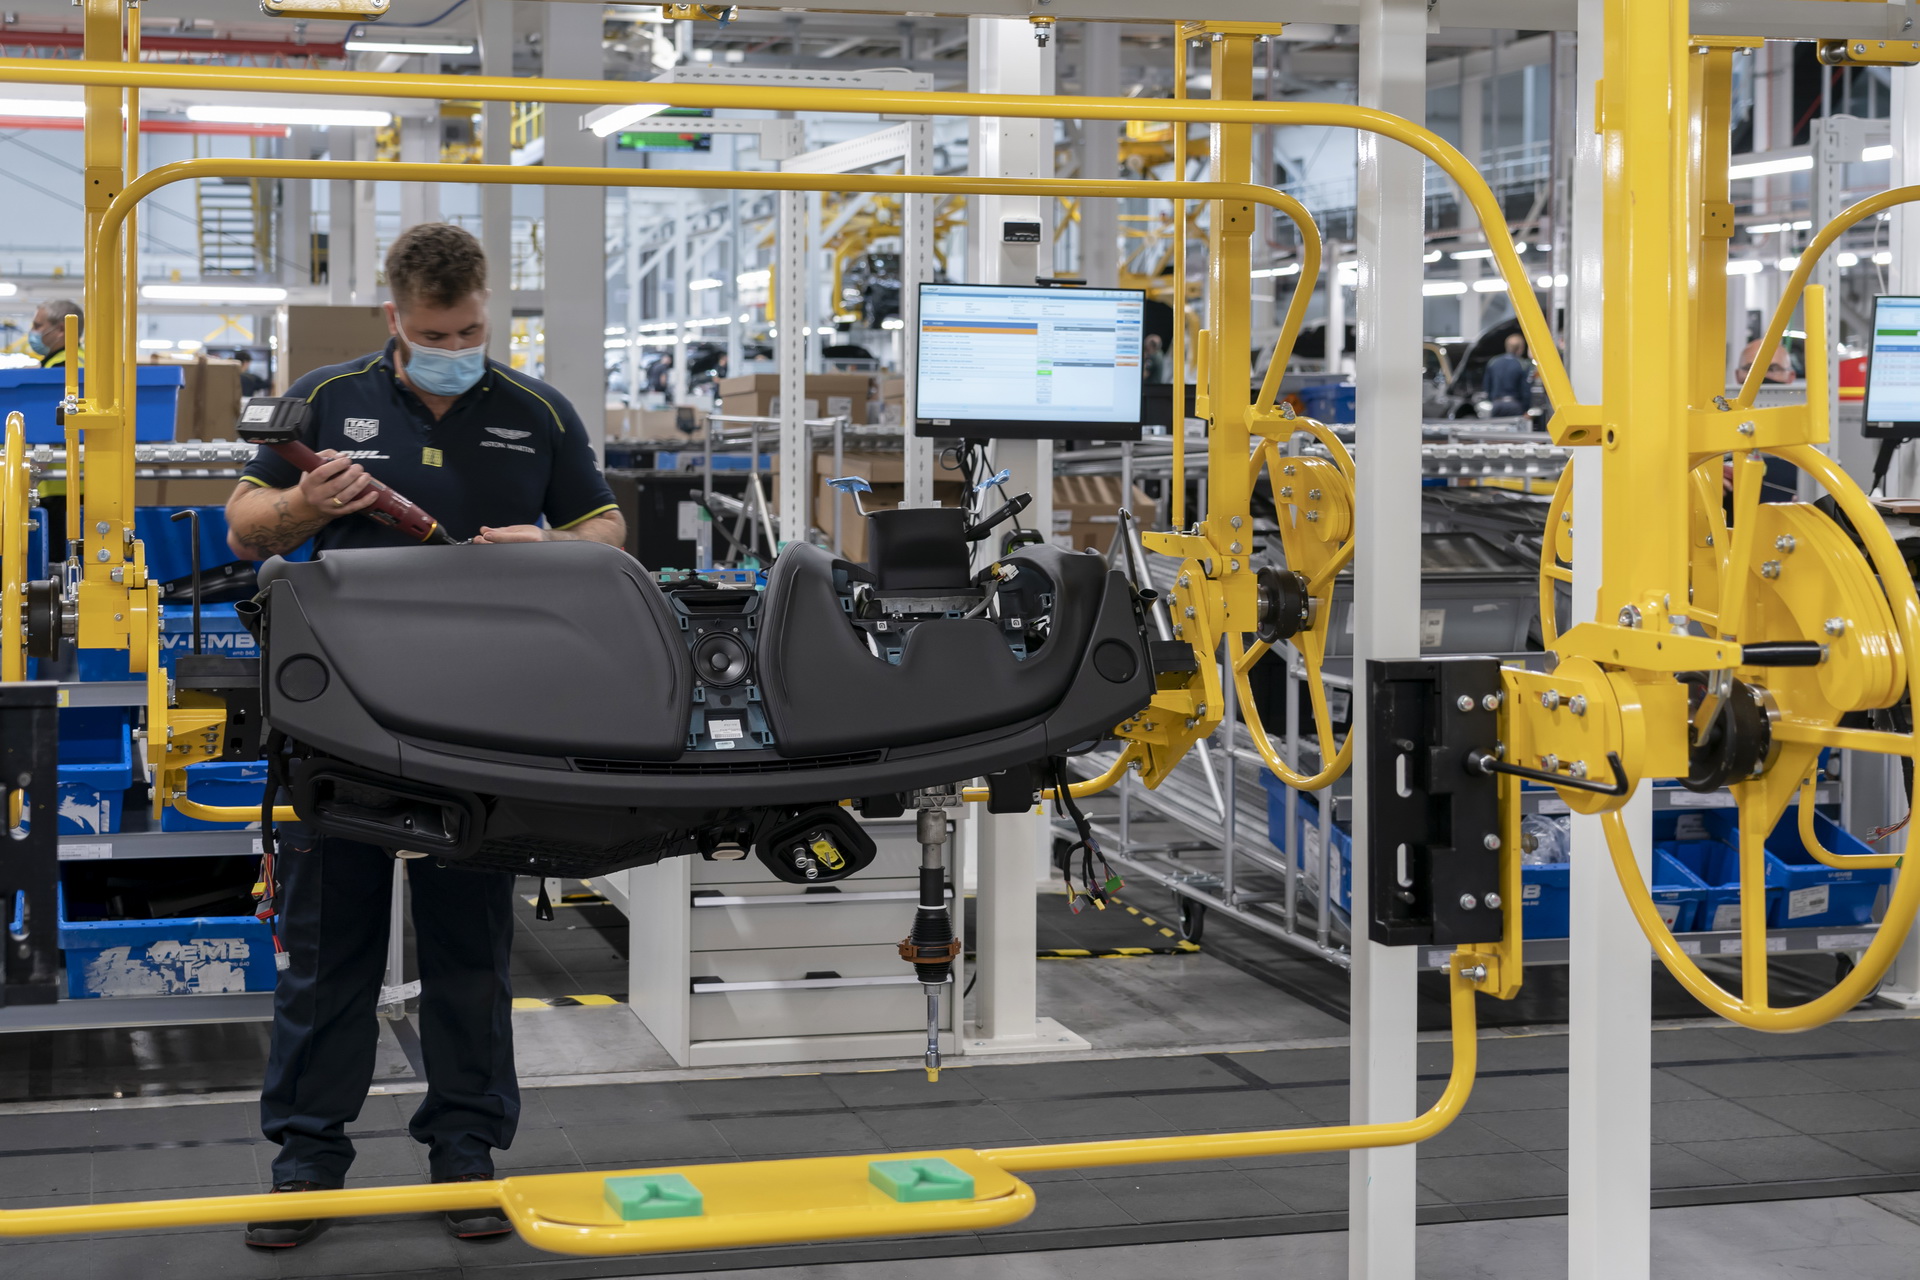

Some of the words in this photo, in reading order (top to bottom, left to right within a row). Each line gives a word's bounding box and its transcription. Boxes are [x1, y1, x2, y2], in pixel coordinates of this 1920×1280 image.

[347, 420, 377, 428] TAG
[480, 440, 506, 448] ASTON
[159, 633, 256, 649] V-EMB
